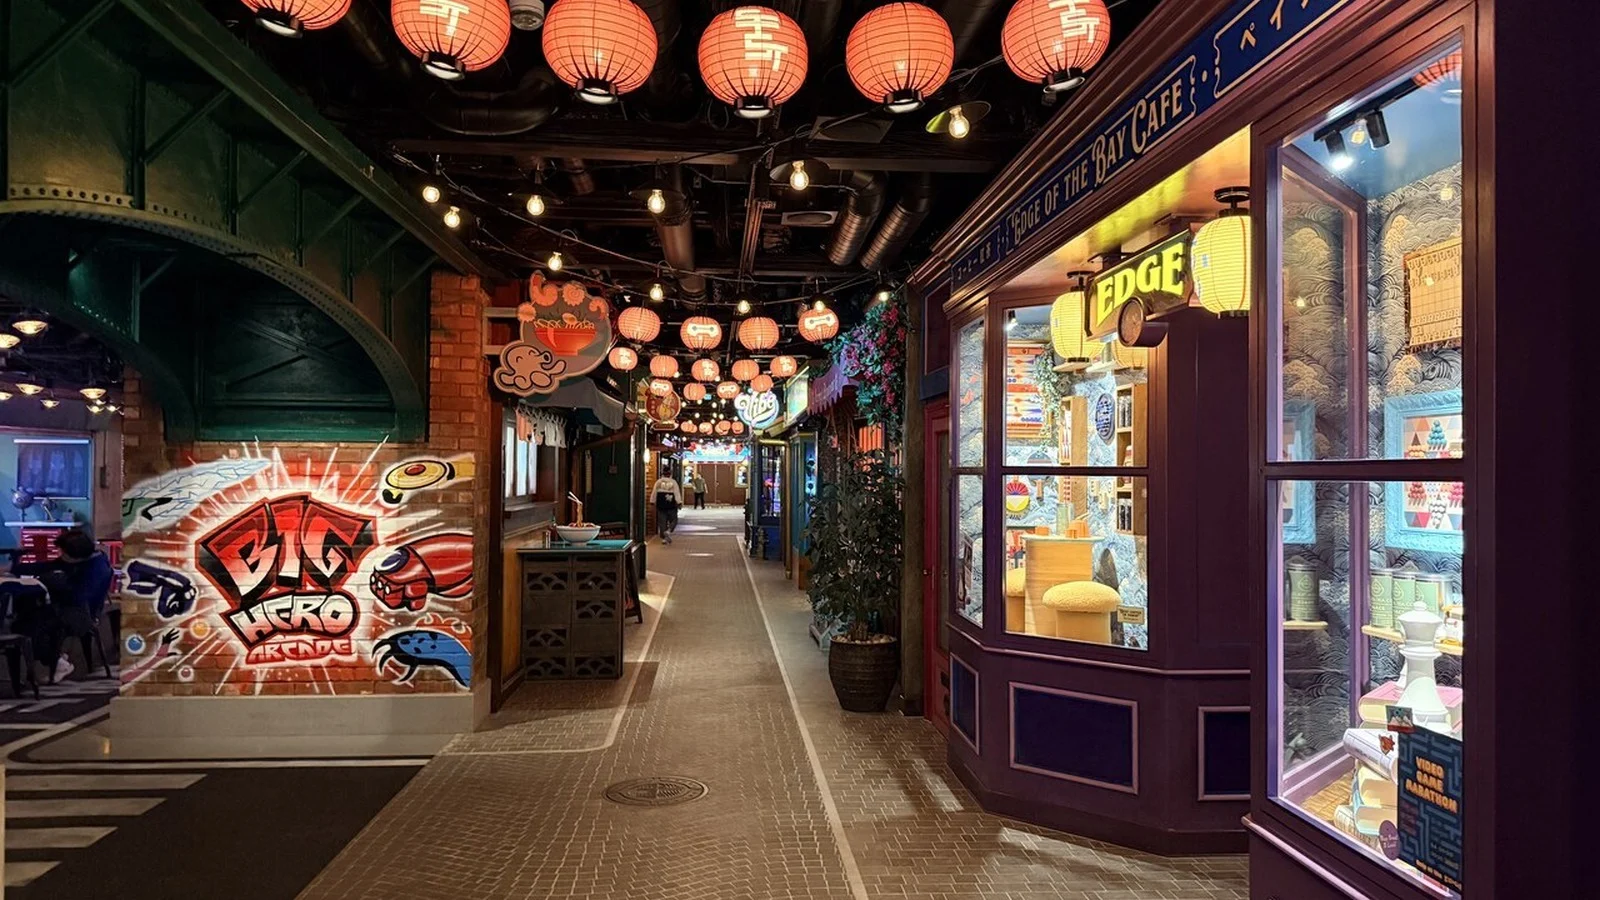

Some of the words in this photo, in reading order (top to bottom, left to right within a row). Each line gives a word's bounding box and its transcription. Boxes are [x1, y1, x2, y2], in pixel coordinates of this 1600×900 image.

[1011, 199, 1041, 246] EDGE
[1044, 184, 1060, 215] OF
[1063, 159, 1089, 202] THE
[1091, 125, 1127, 187] BAY
[1131, 78, 1183, 155] CAFE
[1095, 241, 1186, 328] EDGE
[203, 495, 375, 600] BIG
[229, 593, 357, 643] HERO
[246, 635, 354, 664] ARCADE
[1415, 756, 1445, 778] VIDEO
[1415, 770, 1445, 793] GAME
[1405, 778, 1458, 814] MARATHON
